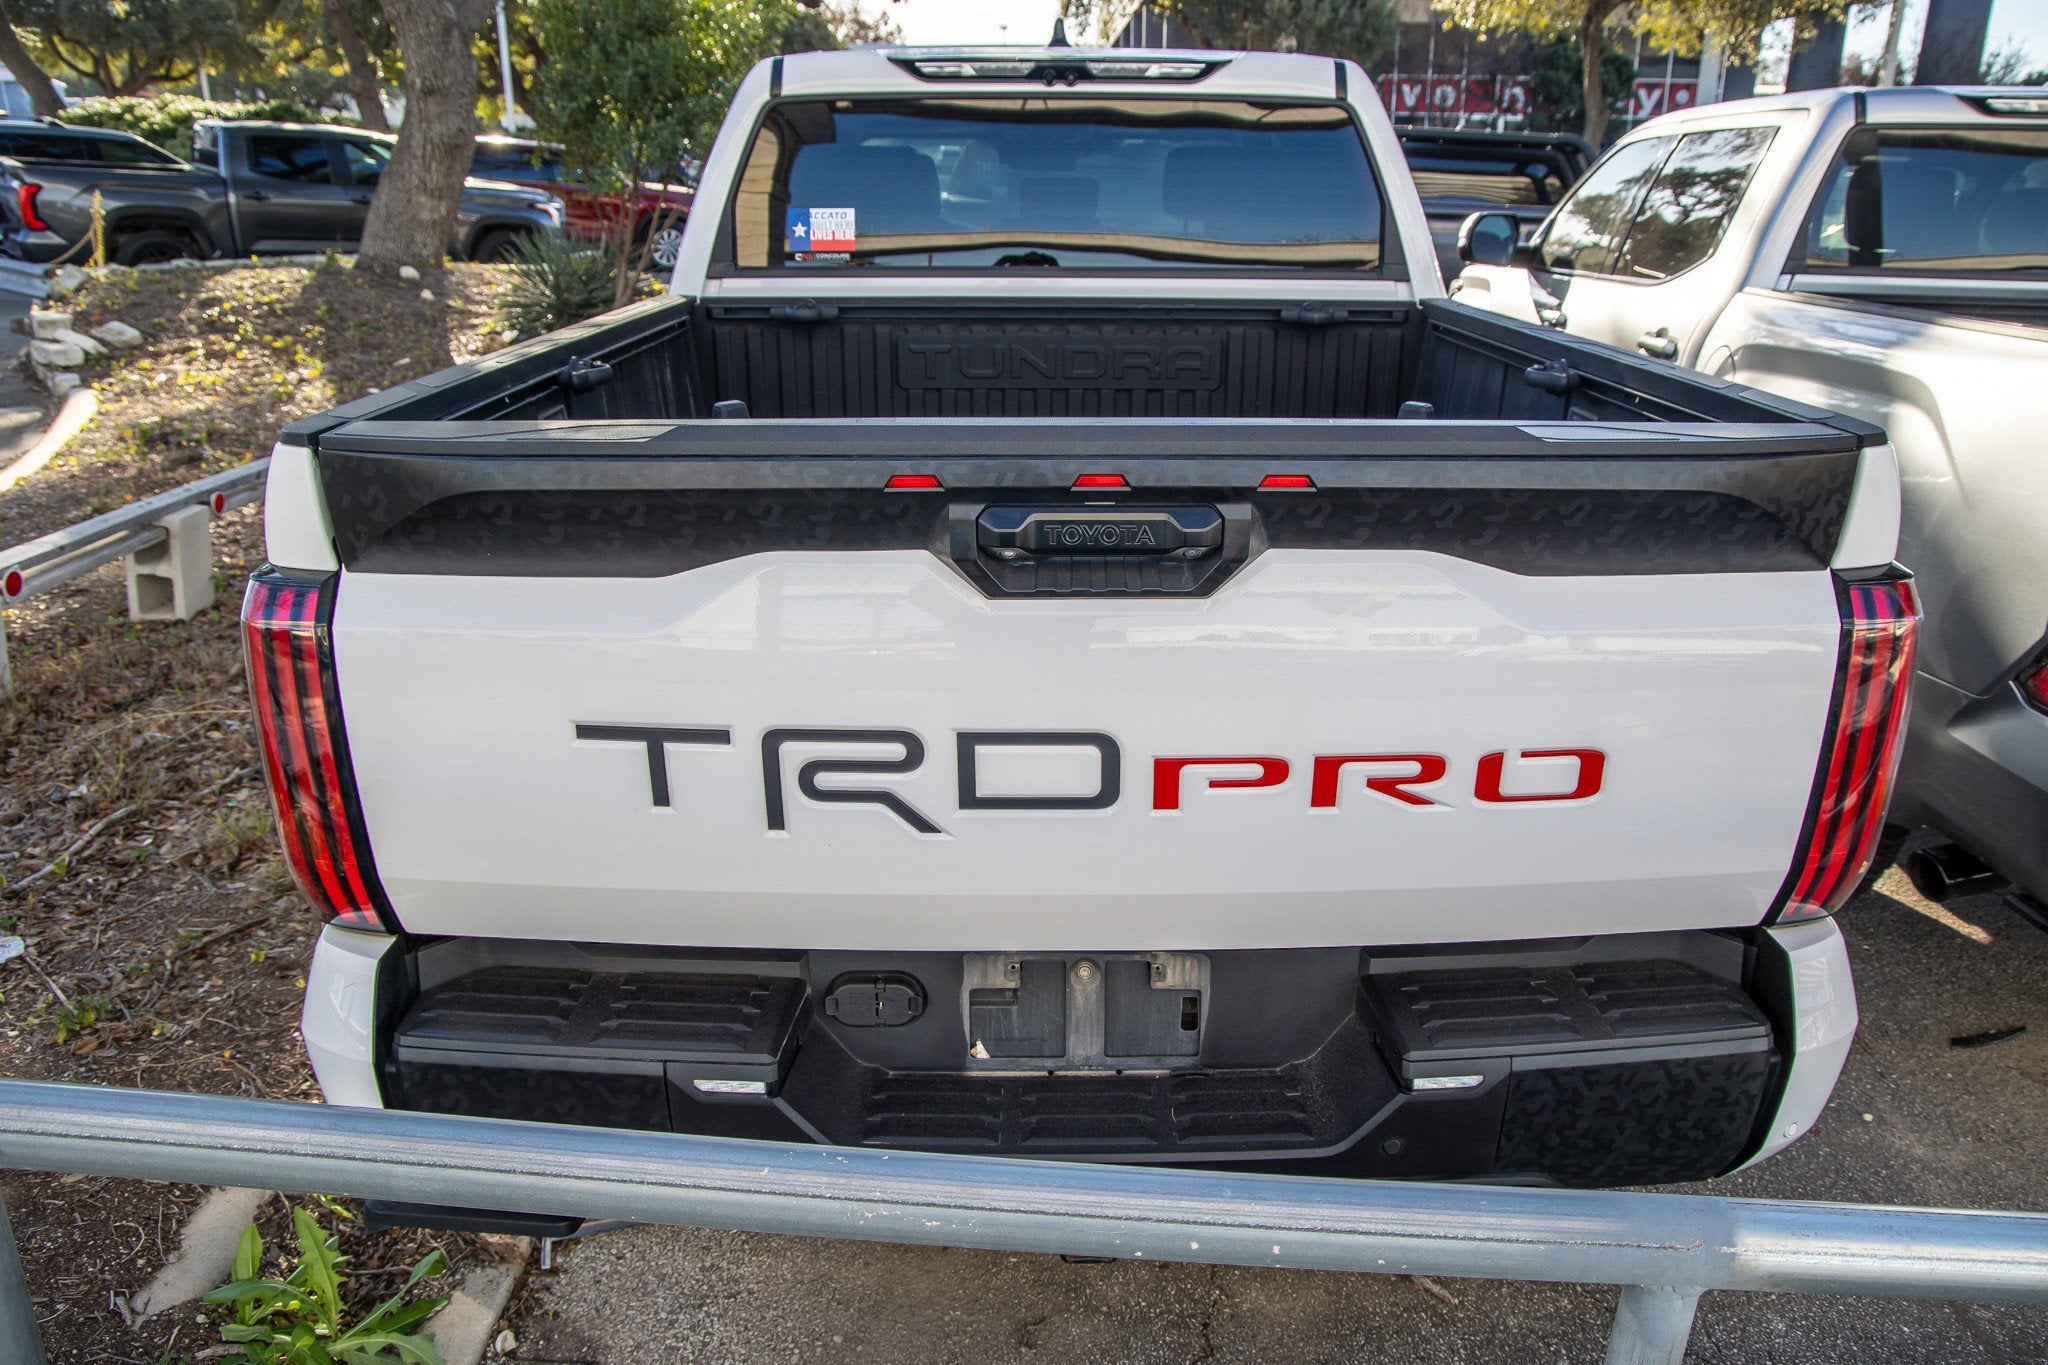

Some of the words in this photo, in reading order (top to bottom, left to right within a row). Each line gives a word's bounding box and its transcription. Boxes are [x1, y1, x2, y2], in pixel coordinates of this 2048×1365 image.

[811, 220, 833, 230] BUILT
[834, 220, 855, 230] HERE
[811, 229, 833, 240] LIVES
[834, 229, 856, 240] HERE
[908, 344, 1211, 379] TUNDRA
[1044, 524, 1156, 546] TOYOTA
[573, 723, 1122, 834] TRD
[1151, 749, 1606, 809] PRO
